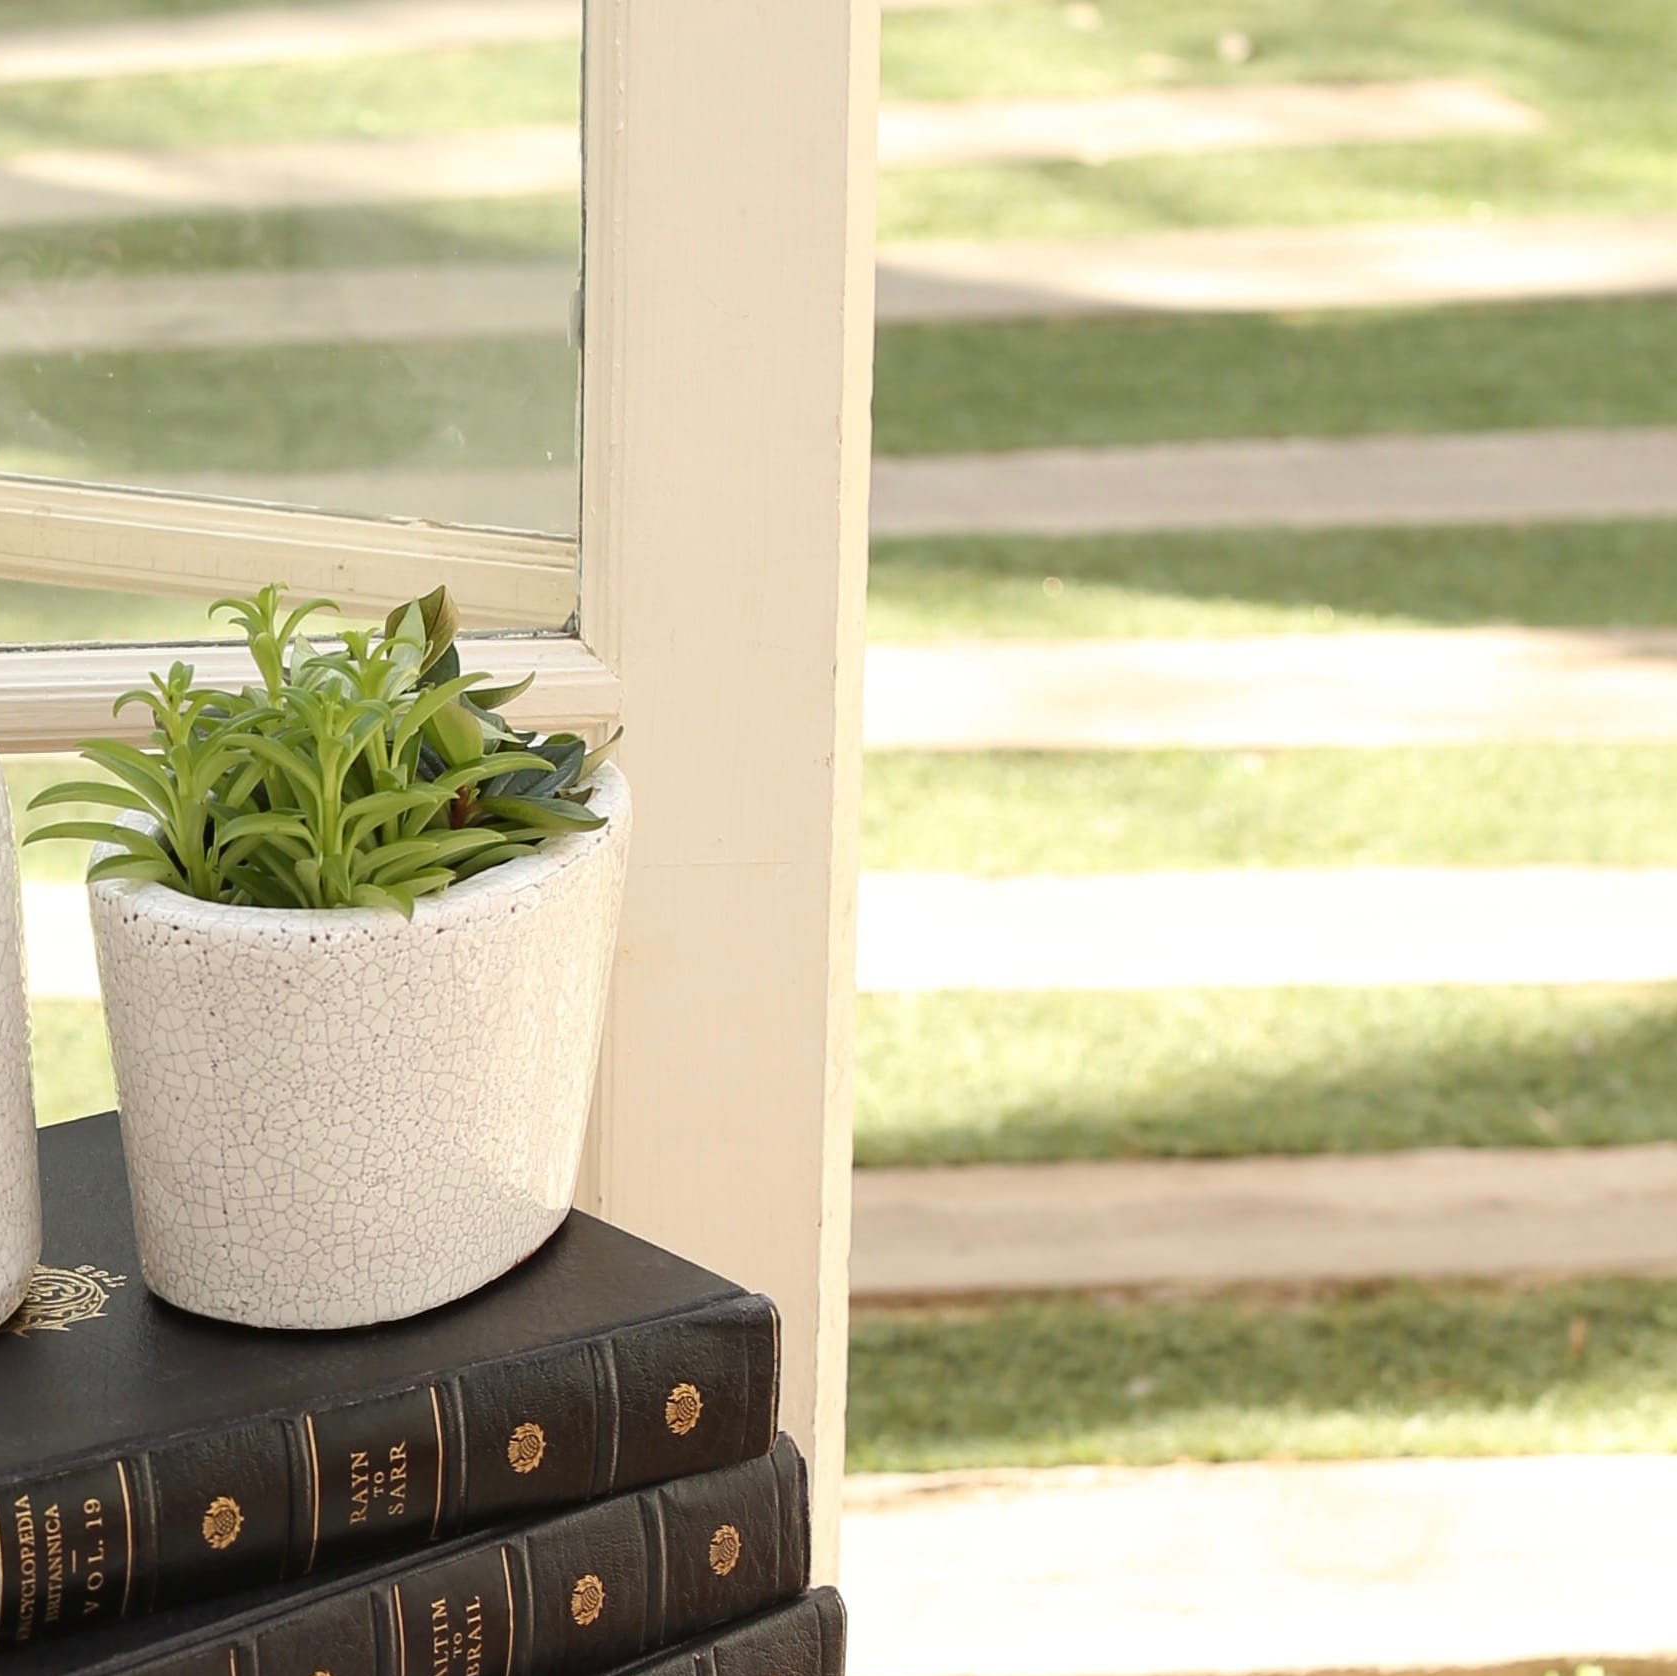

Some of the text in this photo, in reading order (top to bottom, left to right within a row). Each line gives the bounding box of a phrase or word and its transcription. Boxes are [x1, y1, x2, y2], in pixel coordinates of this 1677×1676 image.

[350, 1451, 369, 1524] RAYN
[374, 1471, 385, 1498] TO
[388, 1440, 407, 1515] SARR
[44, 1504, 62, 1621] BRITANNICA
[84, 1498, 104, 1614] VOL. 19
[453, 1632, 462, 1658] TO
